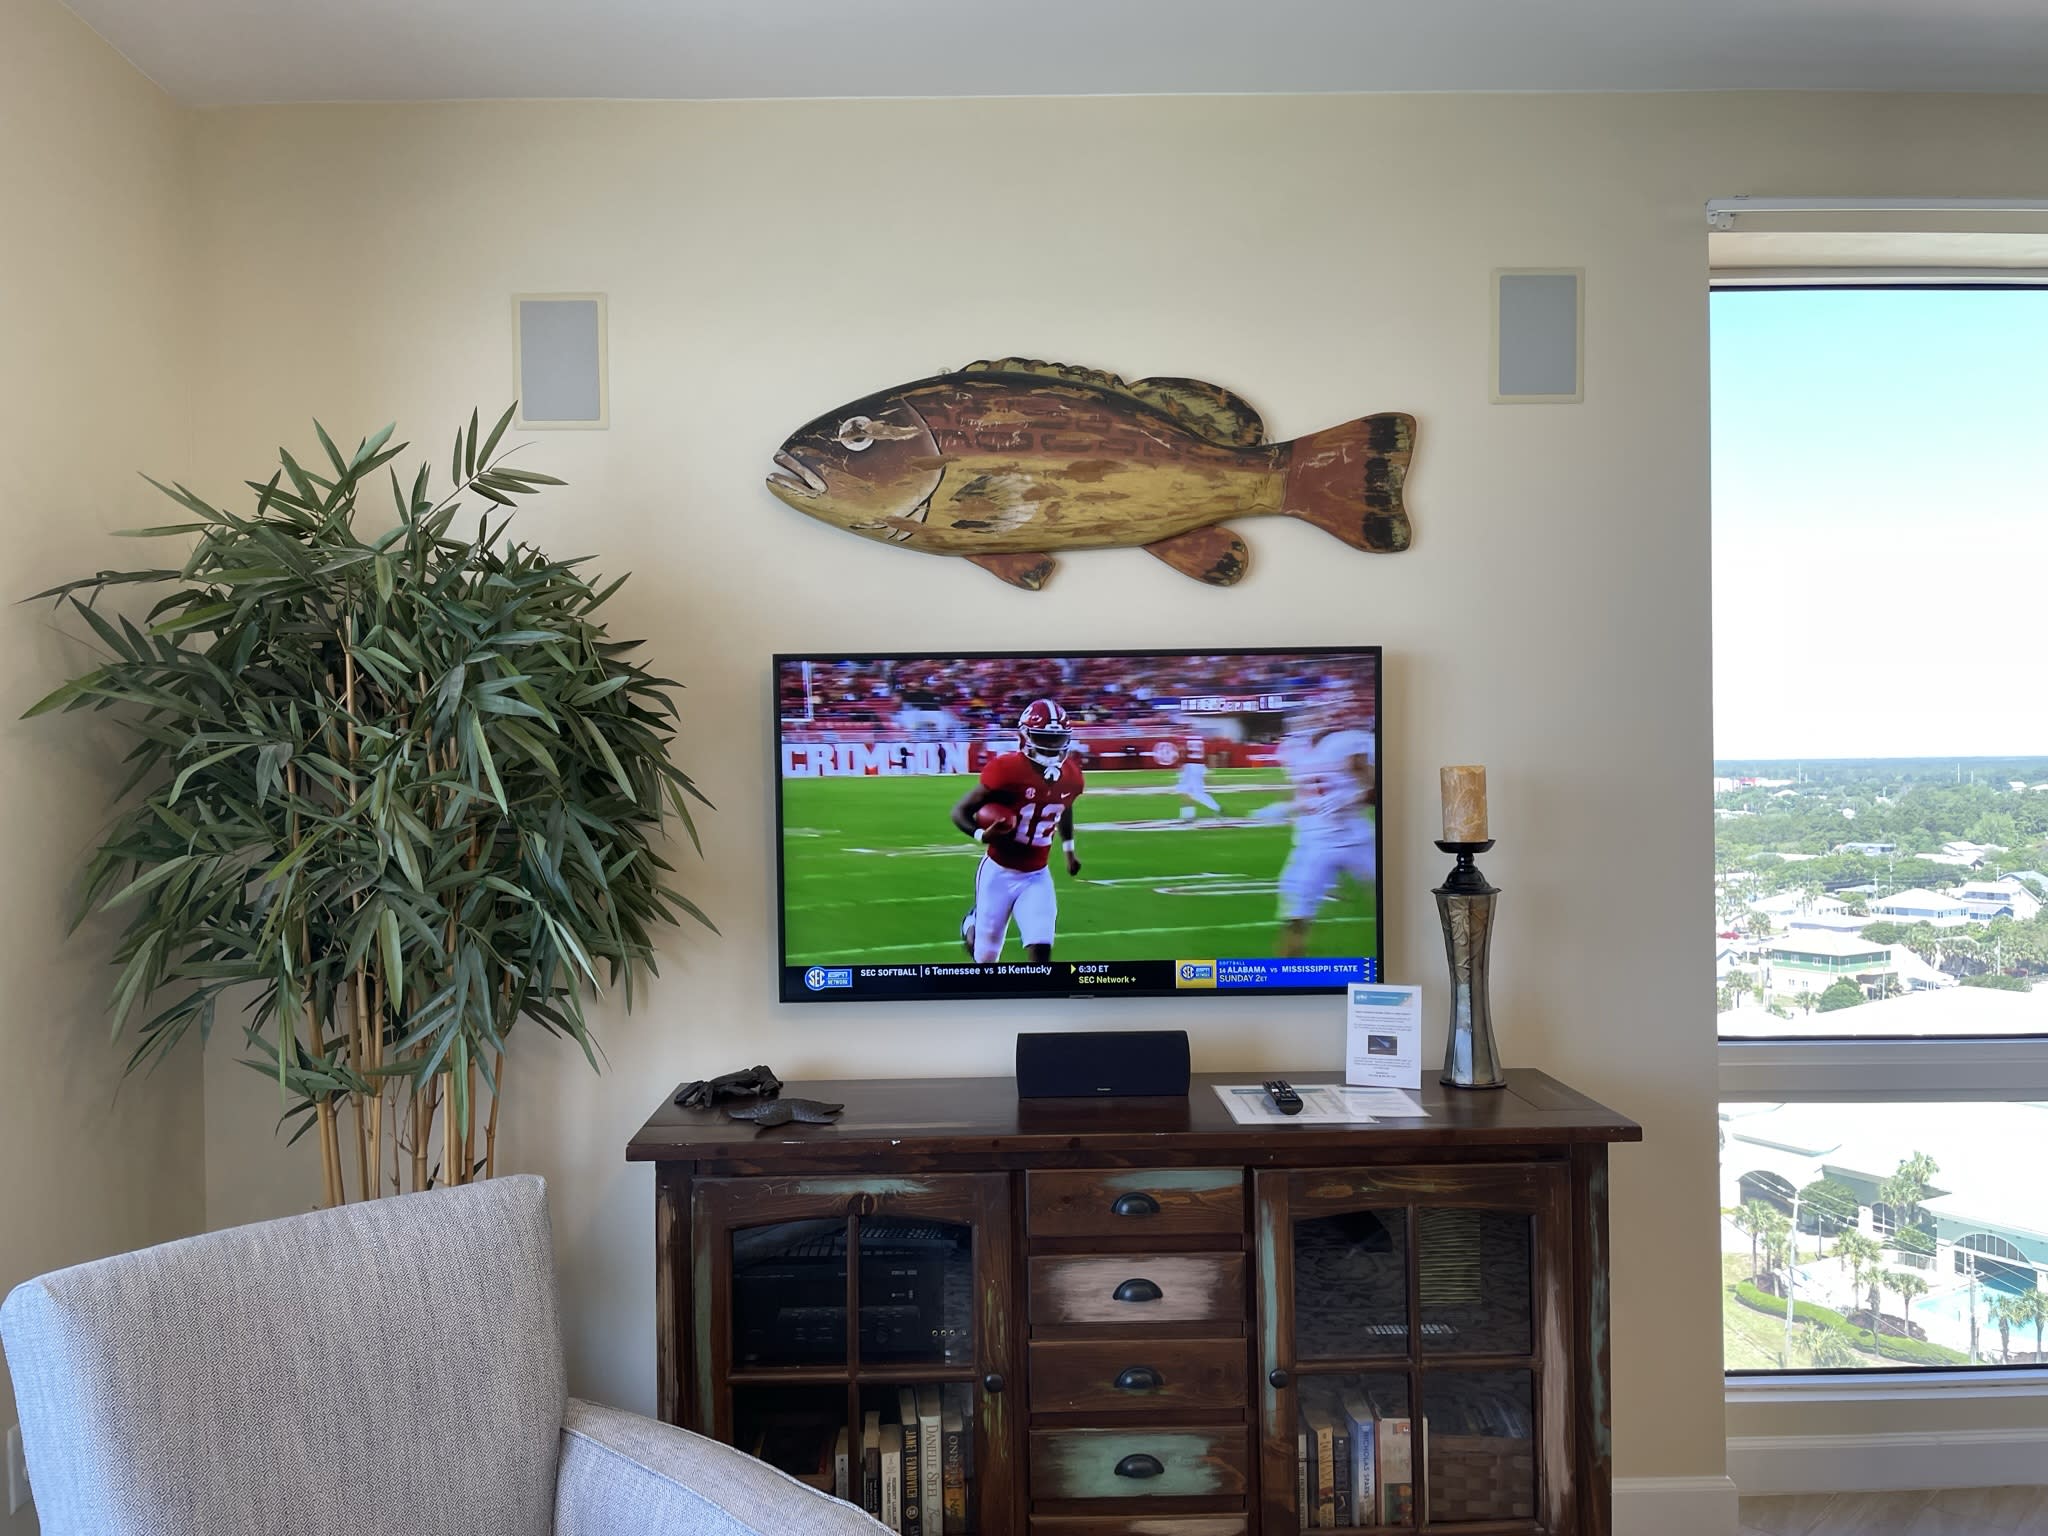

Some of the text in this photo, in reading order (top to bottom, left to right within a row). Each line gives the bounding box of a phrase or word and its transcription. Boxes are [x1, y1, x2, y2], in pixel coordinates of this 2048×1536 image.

[783, 742, 969, 777] CRIMSON
[1015, 802, 1065, 847] 12
[861, 968, 918, 977] SEC SOFTBALL
[924, 965, 1053, 976] 6 Tennessee vs 16 Kentucky
[1078, 965, 1110, 973] 6:30 ET
[1182, 965, 1195, 979] SEC
[1227, 965, 1267, 974] ALABAMA
[1282, 965, 1332, 973] MISSISSIPPI
[1333, 964, 1359, 973] STATE
[808, 970, 826, 987] SEC
[1078, 976, 1095, 984] SEC
[1096, 975, 1130, 984] Network
[1219, 974, 1253, 983] SUNDAY
[926, 1424, 938, 1469] DANIELLE
[905, 1430, 918, 1498] JANET EVANOVICH
[927, 1472, 940, 1497] STEEL
